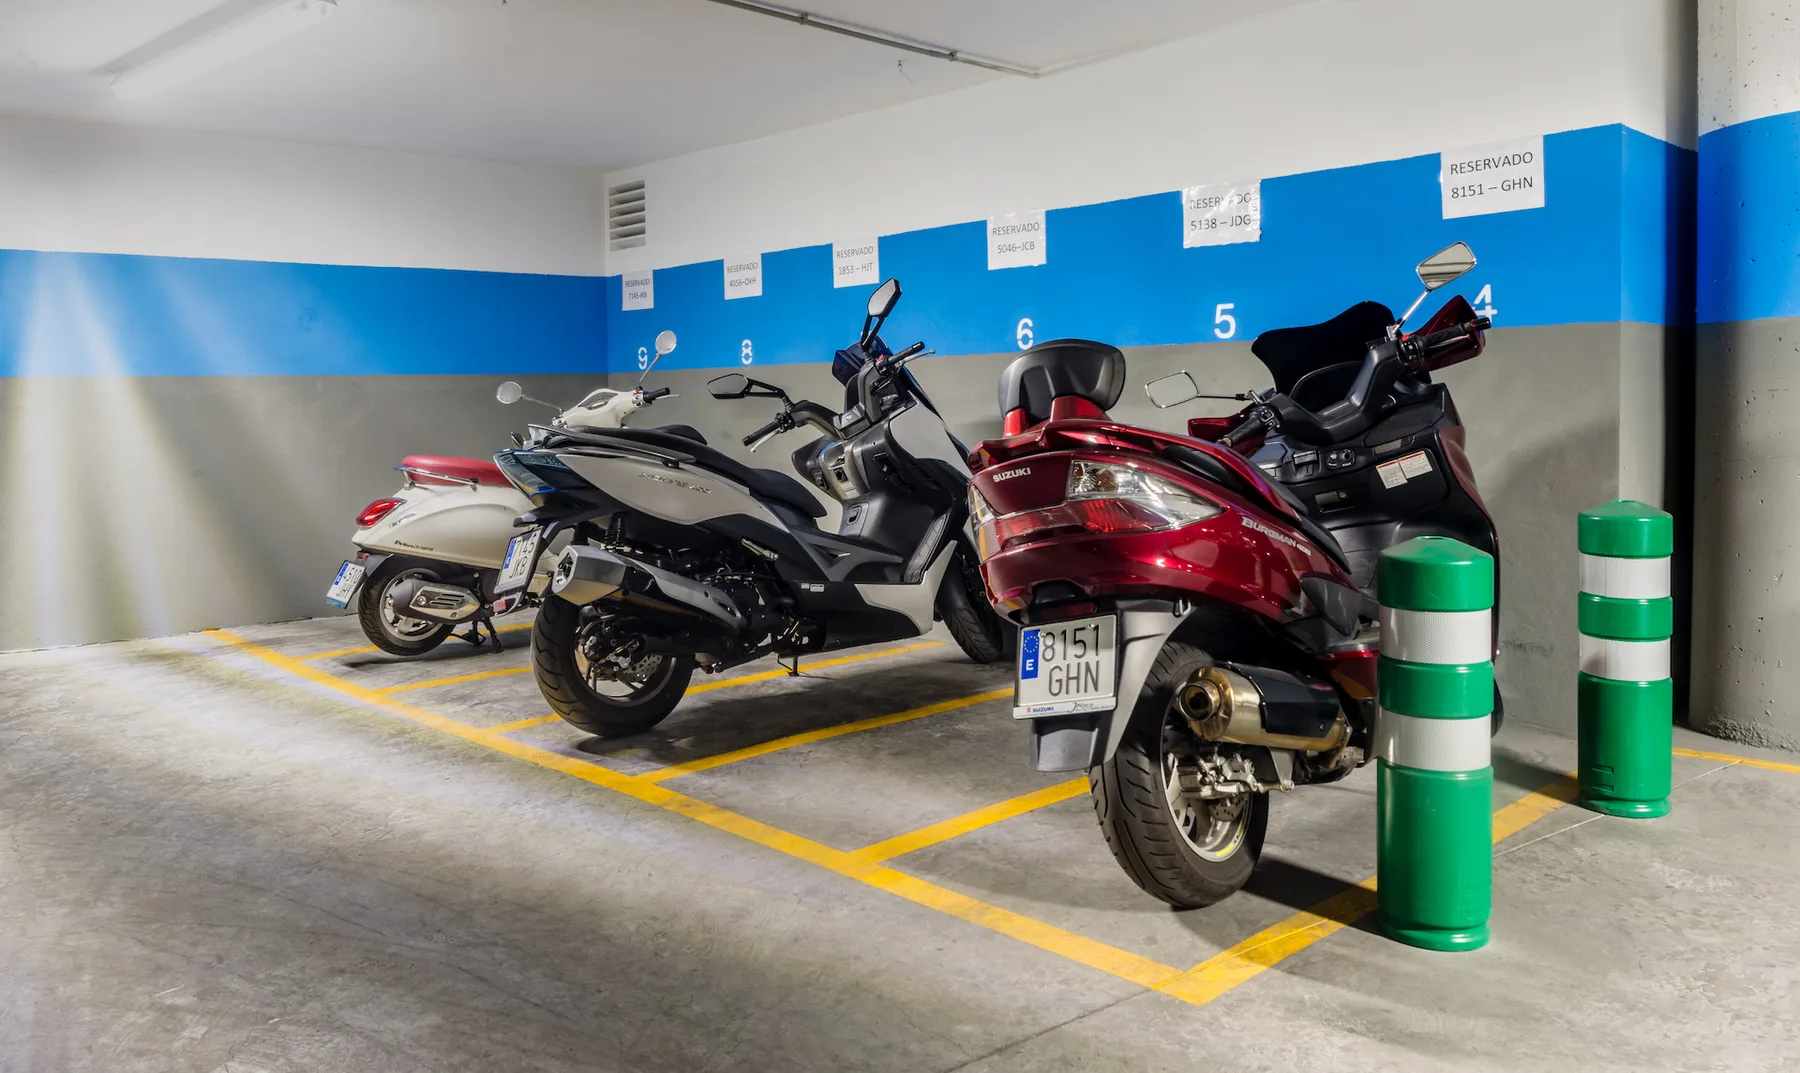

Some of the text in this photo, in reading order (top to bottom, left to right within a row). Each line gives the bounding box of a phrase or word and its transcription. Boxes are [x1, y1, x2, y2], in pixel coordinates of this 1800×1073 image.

[1450, 151, 1533, 175] RESERVADO
[1451, 183, 1484, 199] 8151
[1501, 176, 1533, 192] GHN
[1189, 192, 1252, 210] RESERDO
[992, 221, 1040, 236] RESERVADO
[1190, 218, 1217, 231] 5138
[1230, 214, 1252, 227] JDG
[836, 245, 874, 259] RESERVADO
[727, 262, 758, 273] RESERVADO
[839, 265, 854, 275] 1853
[625, 279, 650, 287] RESERVADO
[1471, 284, 1498, 324] 4
[1213, 302, 1236, 339] 5
[1016, 317, 1034, 350] 6
[638, 346, 648, 370] 9
[741, 339, 753, 365] 8
[992, 467, 1031, 483] SUZUKI
[1241, 516, 1297, 547] BURGMAN
[512, 532, 537, 558] 7145
[509, 556, 528, 579] JKB
[1042, 624, 1100, 662] 8151
[1025, 659, 1034, 671] E
[1048, 660, 1100, 697] GHN
